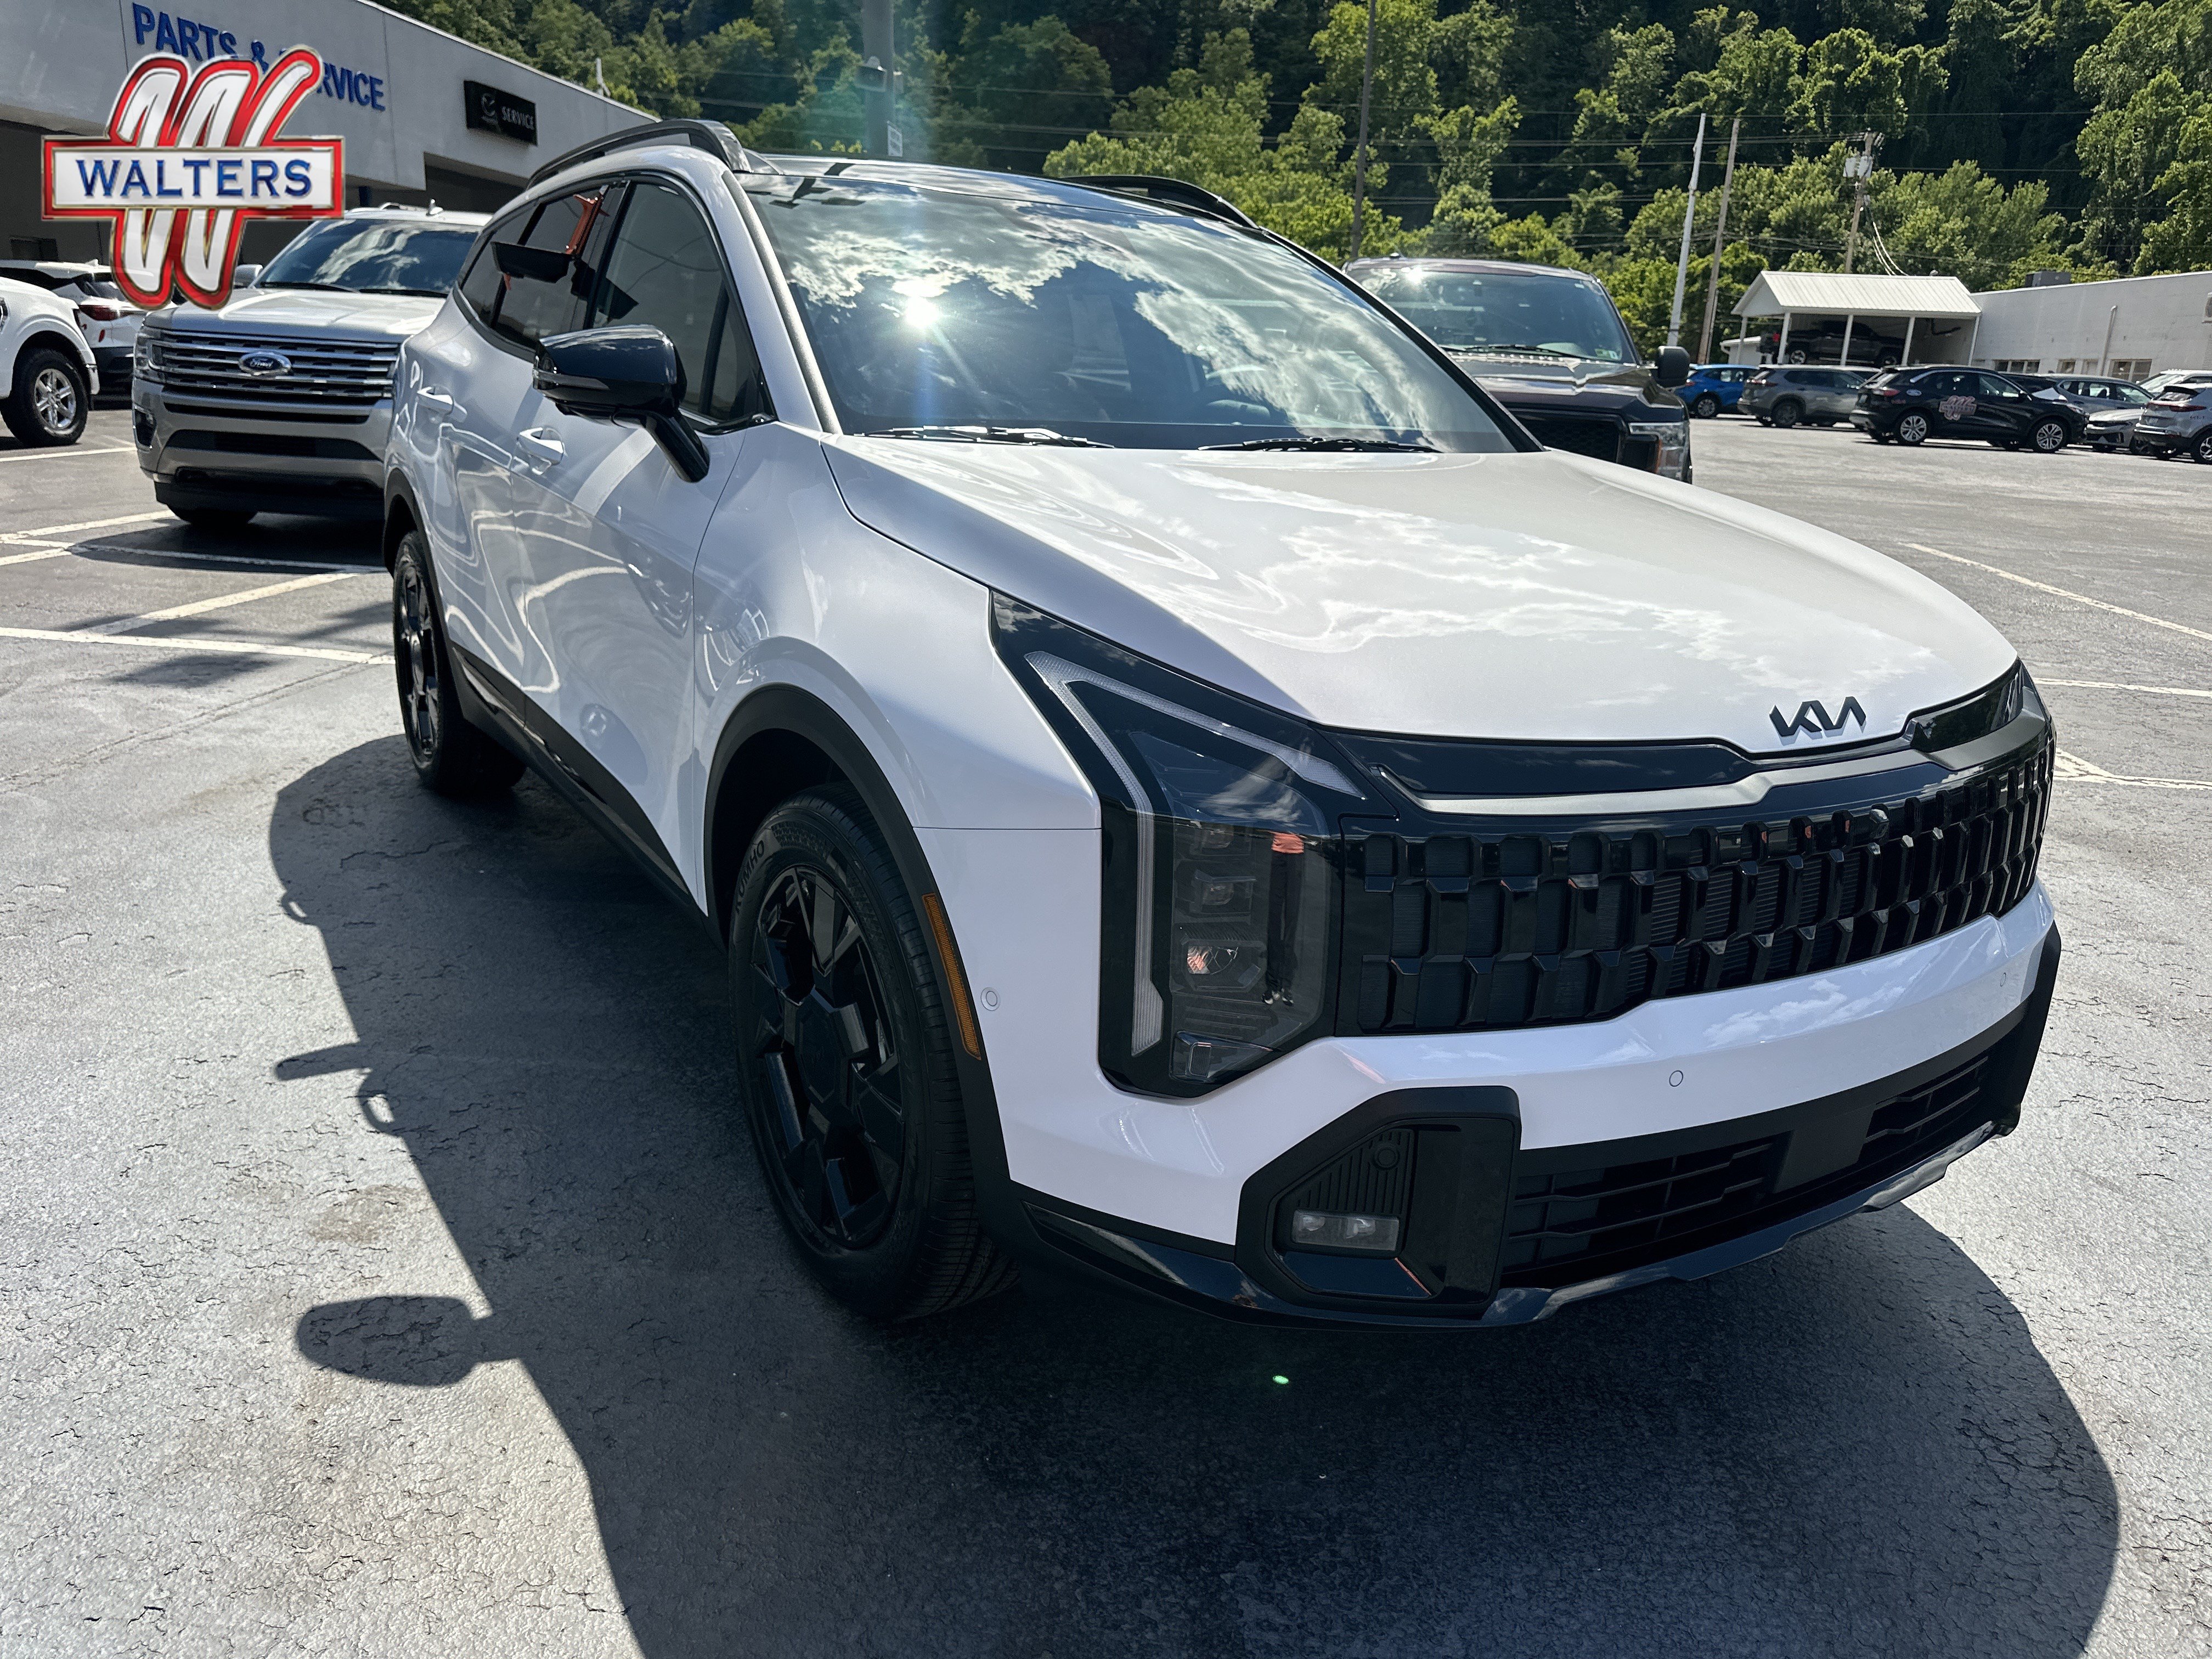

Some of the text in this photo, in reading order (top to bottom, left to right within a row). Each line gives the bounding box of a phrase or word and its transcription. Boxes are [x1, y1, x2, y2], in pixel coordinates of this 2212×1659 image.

[133, 2, 386, 111] PARTS & RVICE
[1769, 696, 1866, 737] KIA
[736, 840, 764, 915] KUMHO
